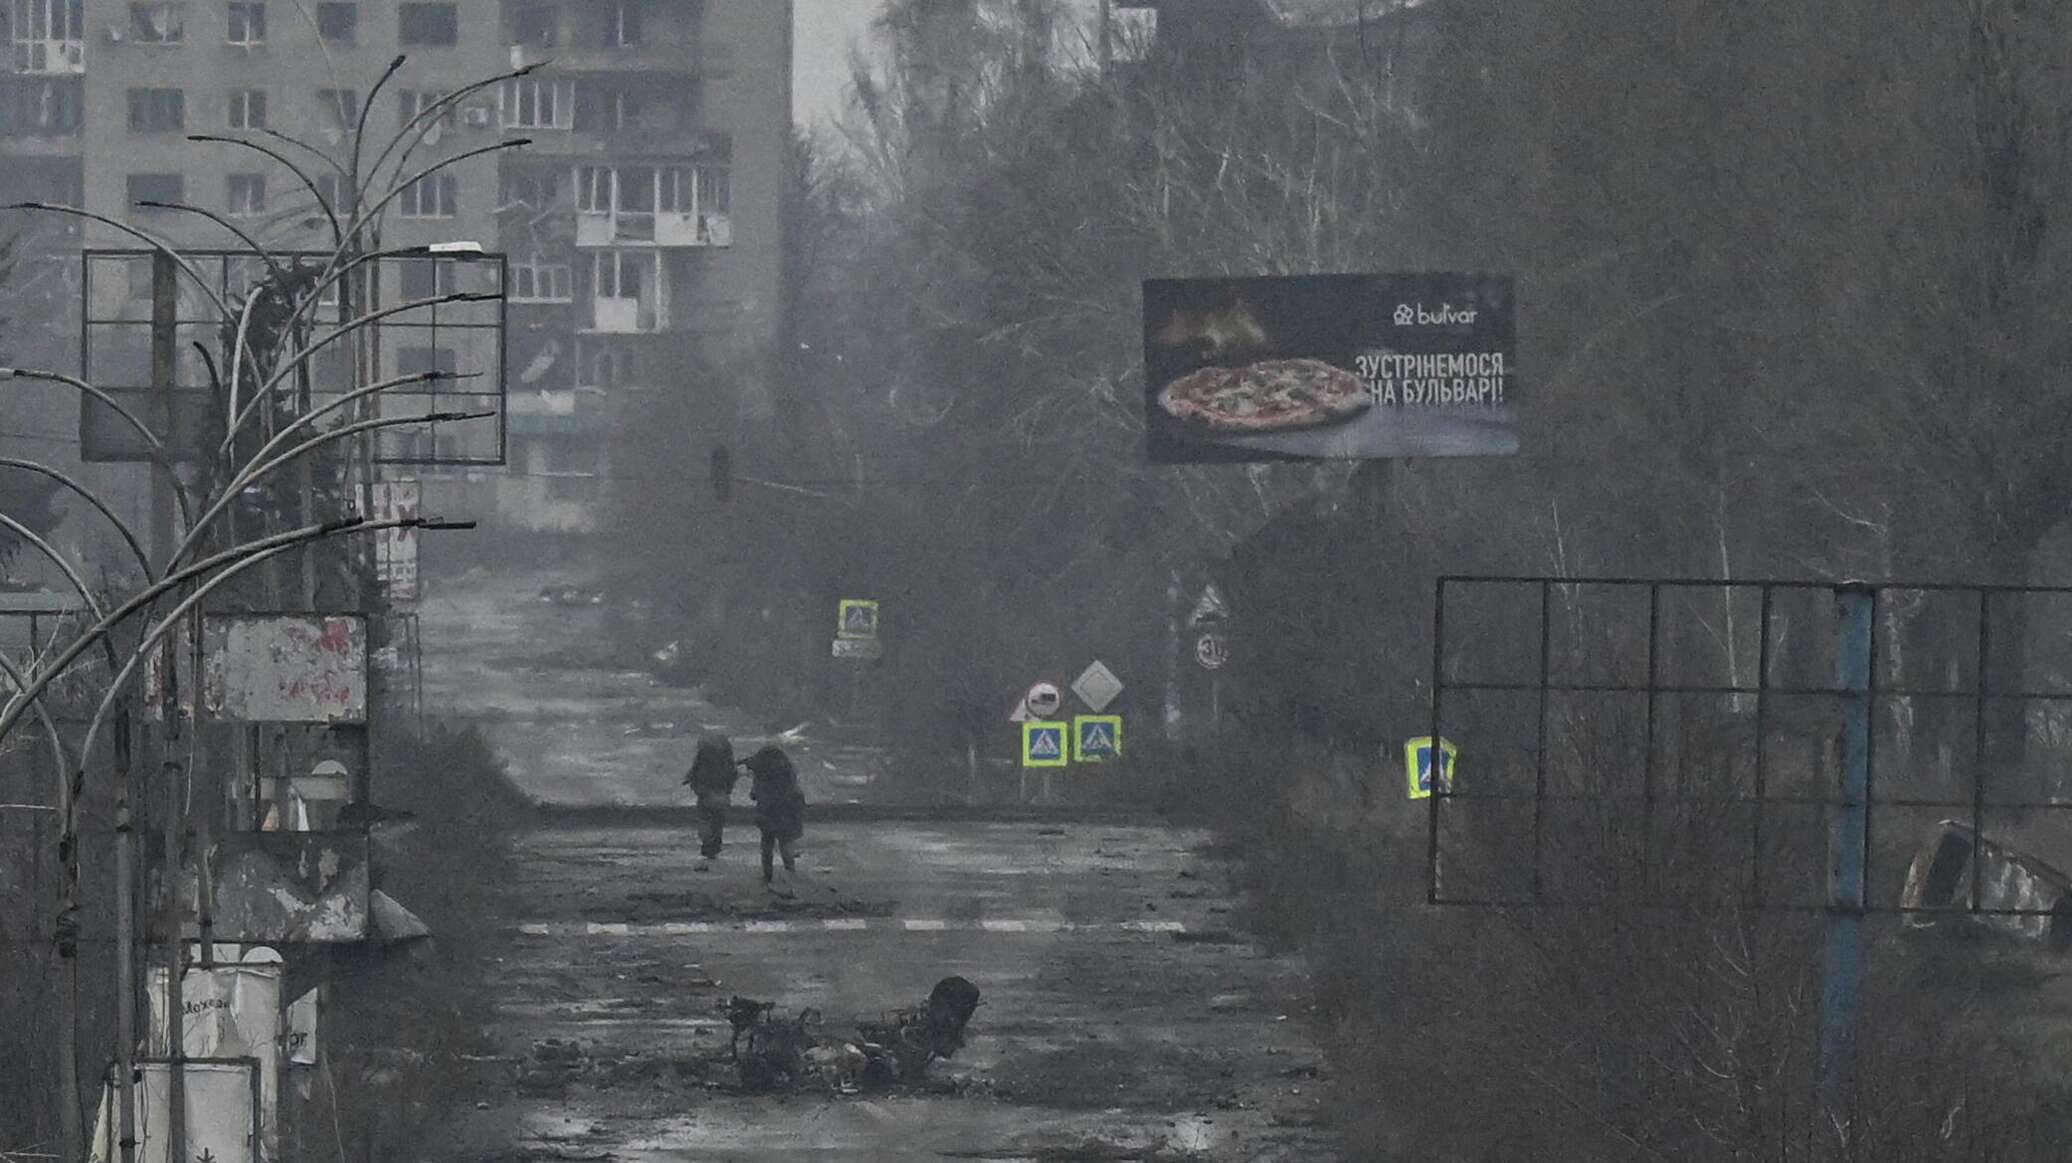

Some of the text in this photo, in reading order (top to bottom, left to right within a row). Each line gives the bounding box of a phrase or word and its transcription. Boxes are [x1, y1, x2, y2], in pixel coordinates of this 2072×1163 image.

[1355, 353, 1504, 379] ЗУСТРІНЕМОСЯ
[1370, 376, 1504, 405] НА БУЛЬВАРІ!
